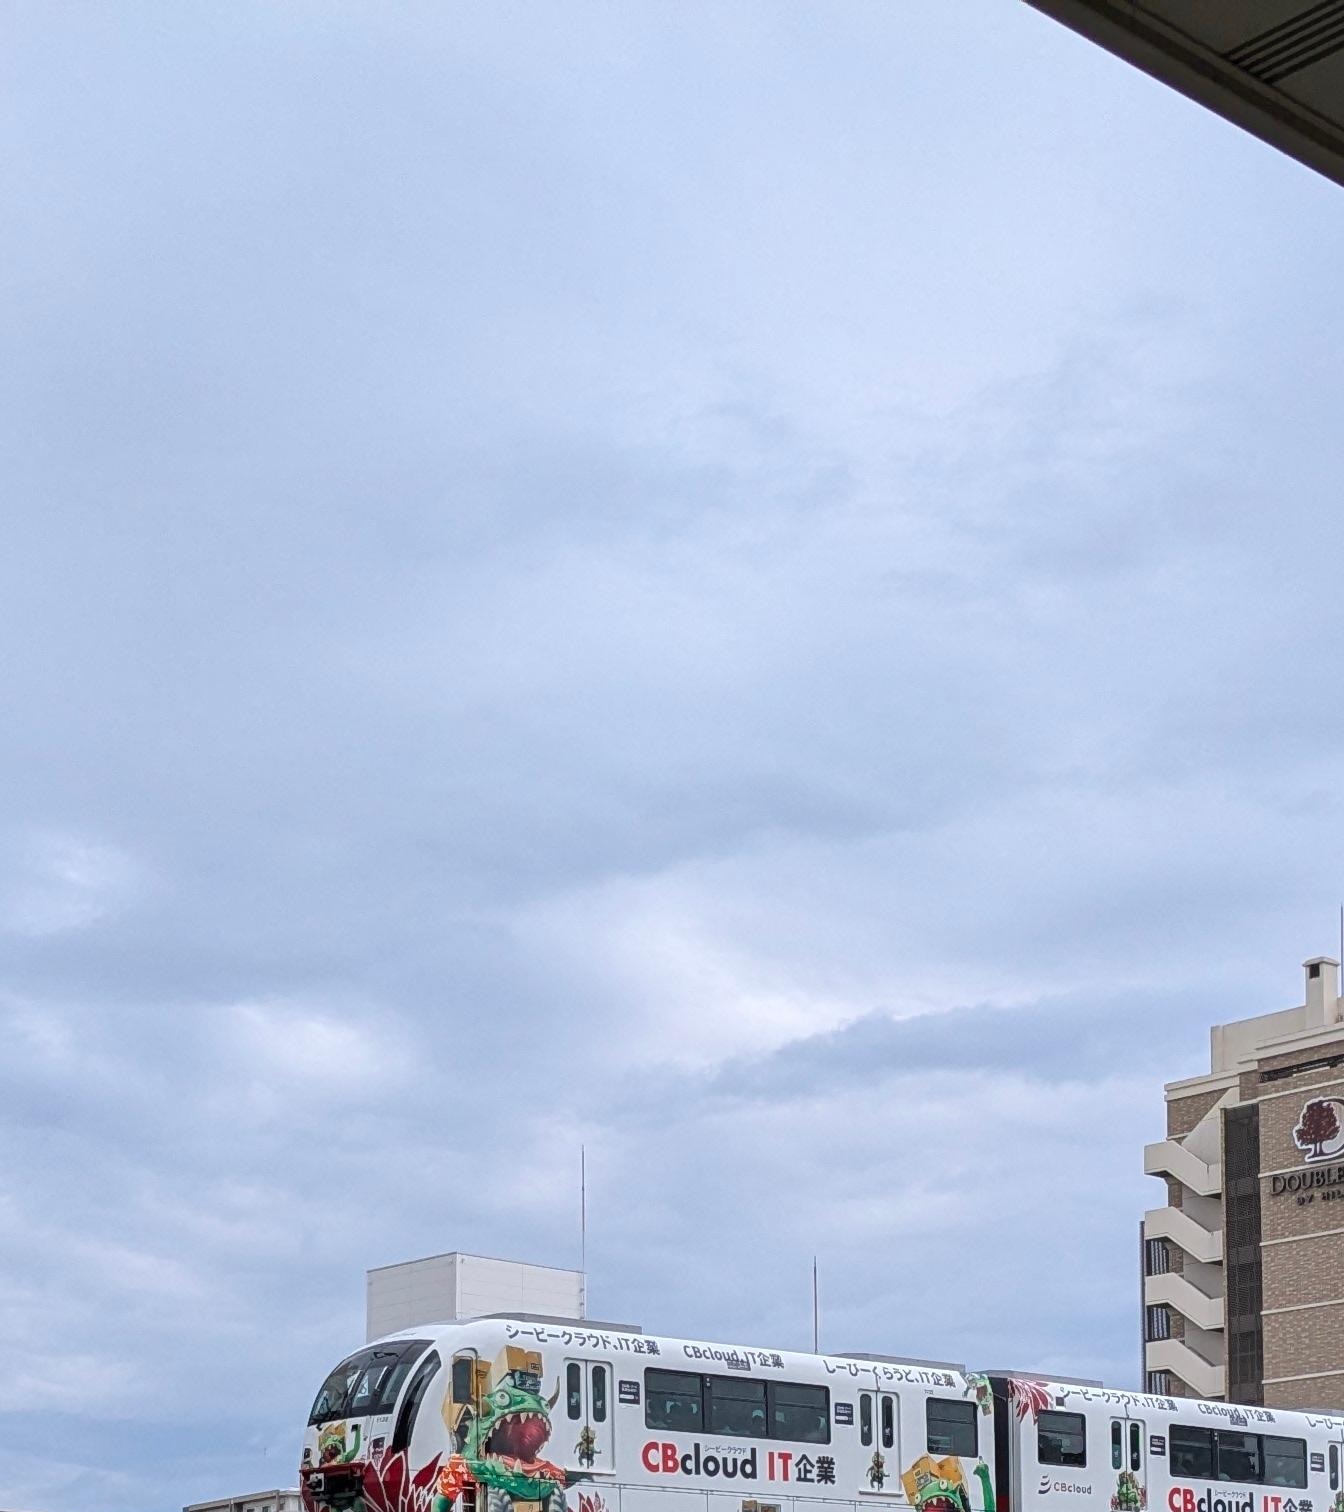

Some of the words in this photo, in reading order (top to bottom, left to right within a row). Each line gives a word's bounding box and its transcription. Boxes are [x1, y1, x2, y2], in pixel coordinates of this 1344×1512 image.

[642, 1442, 757, 1480] CBcloud
[768, 1451, 836, 1485] IT企業
[1054, 1482, 1092, 1494] CBcloud
